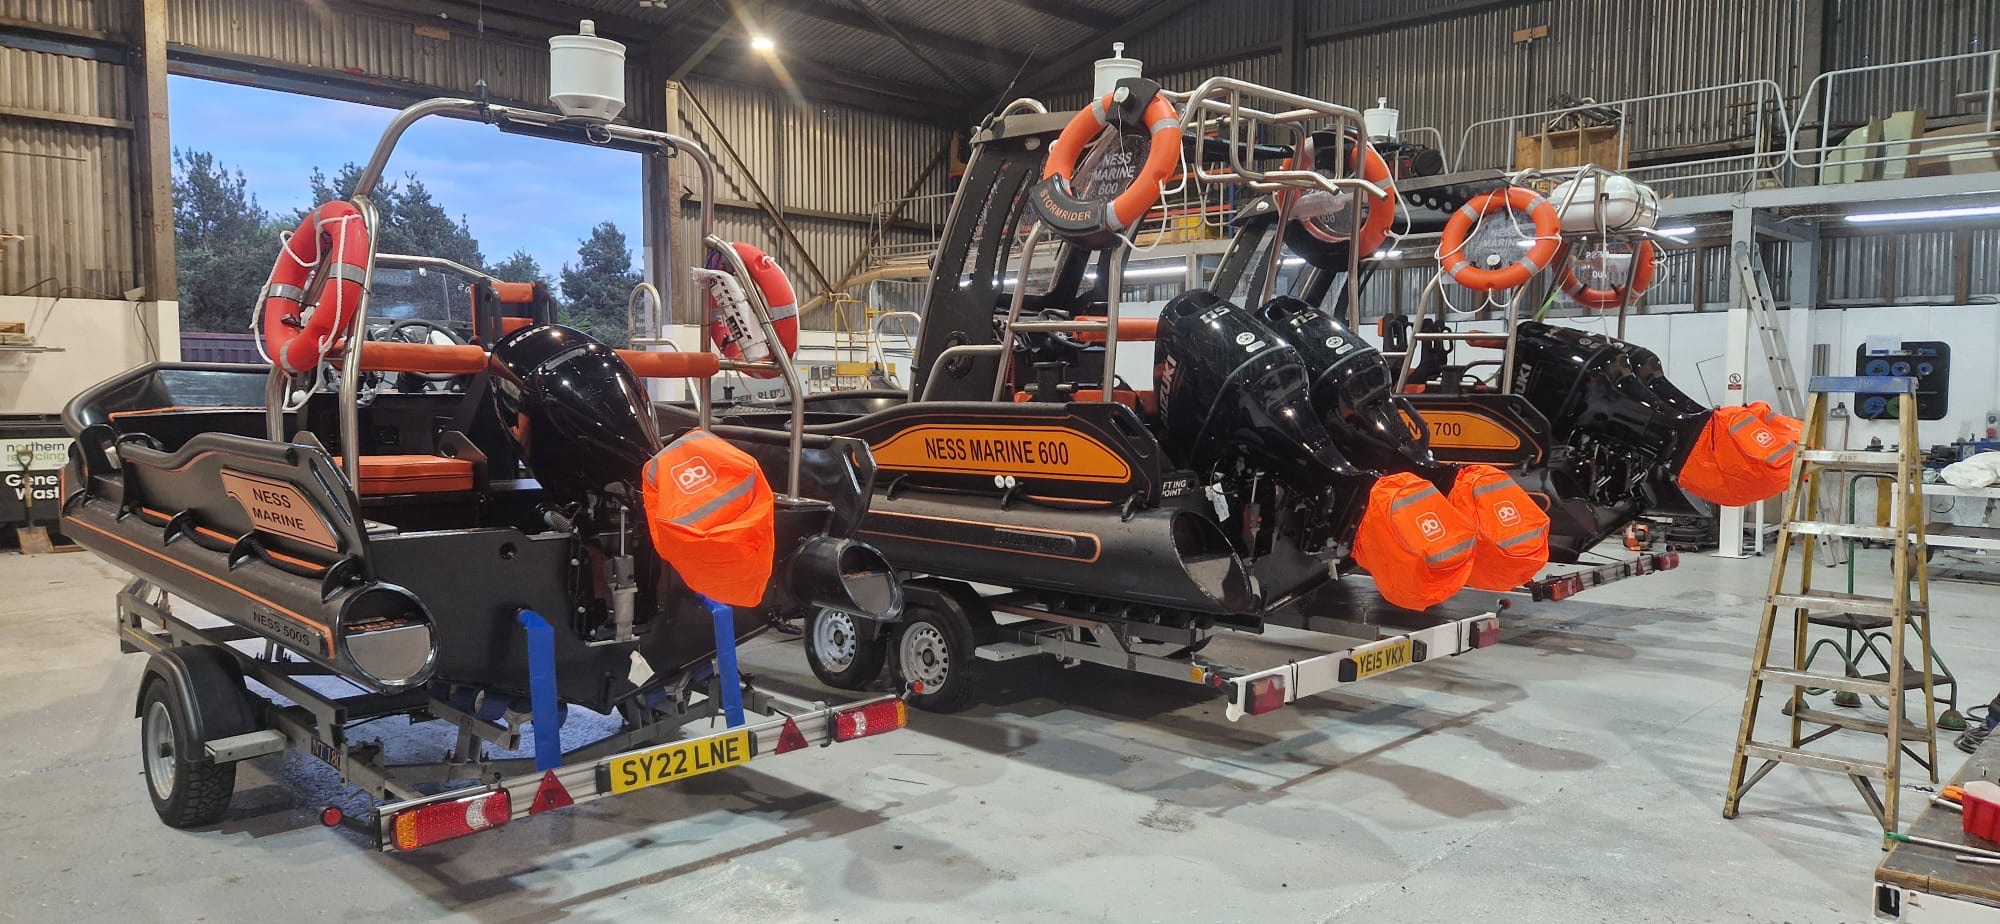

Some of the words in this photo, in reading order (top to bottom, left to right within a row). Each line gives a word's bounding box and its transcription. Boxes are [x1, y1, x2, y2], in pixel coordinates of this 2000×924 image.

[1103, 152, 1133, 165] NESS
[1091, 165, 1136, 181] MARINE
[1098, 182, 1119, 195] 600
[1040, 189, 1092, 221] STORMRIDER
[1434, 422, 1462, 437] 700
[7, 441, 65, 452] northern
[925, 437, 967, 461] NESS
[969, 439, 1035, 464] MARINE
[1038, 441, 1069, 466] 600
[5, 473, 58, 487] Gene
[15, 486, 60, 500] Wast
[252, 488, 291, 509] NESS
[252, 507, 306, 531] MARINE
[253, 611, 281, 633] NESS
[283, 625, 310, 647] 500S
[1386, 644, 1405, 667] VKX
[622, 749, 688, 786] SY22
[694, 737, 741, 770] LNE
